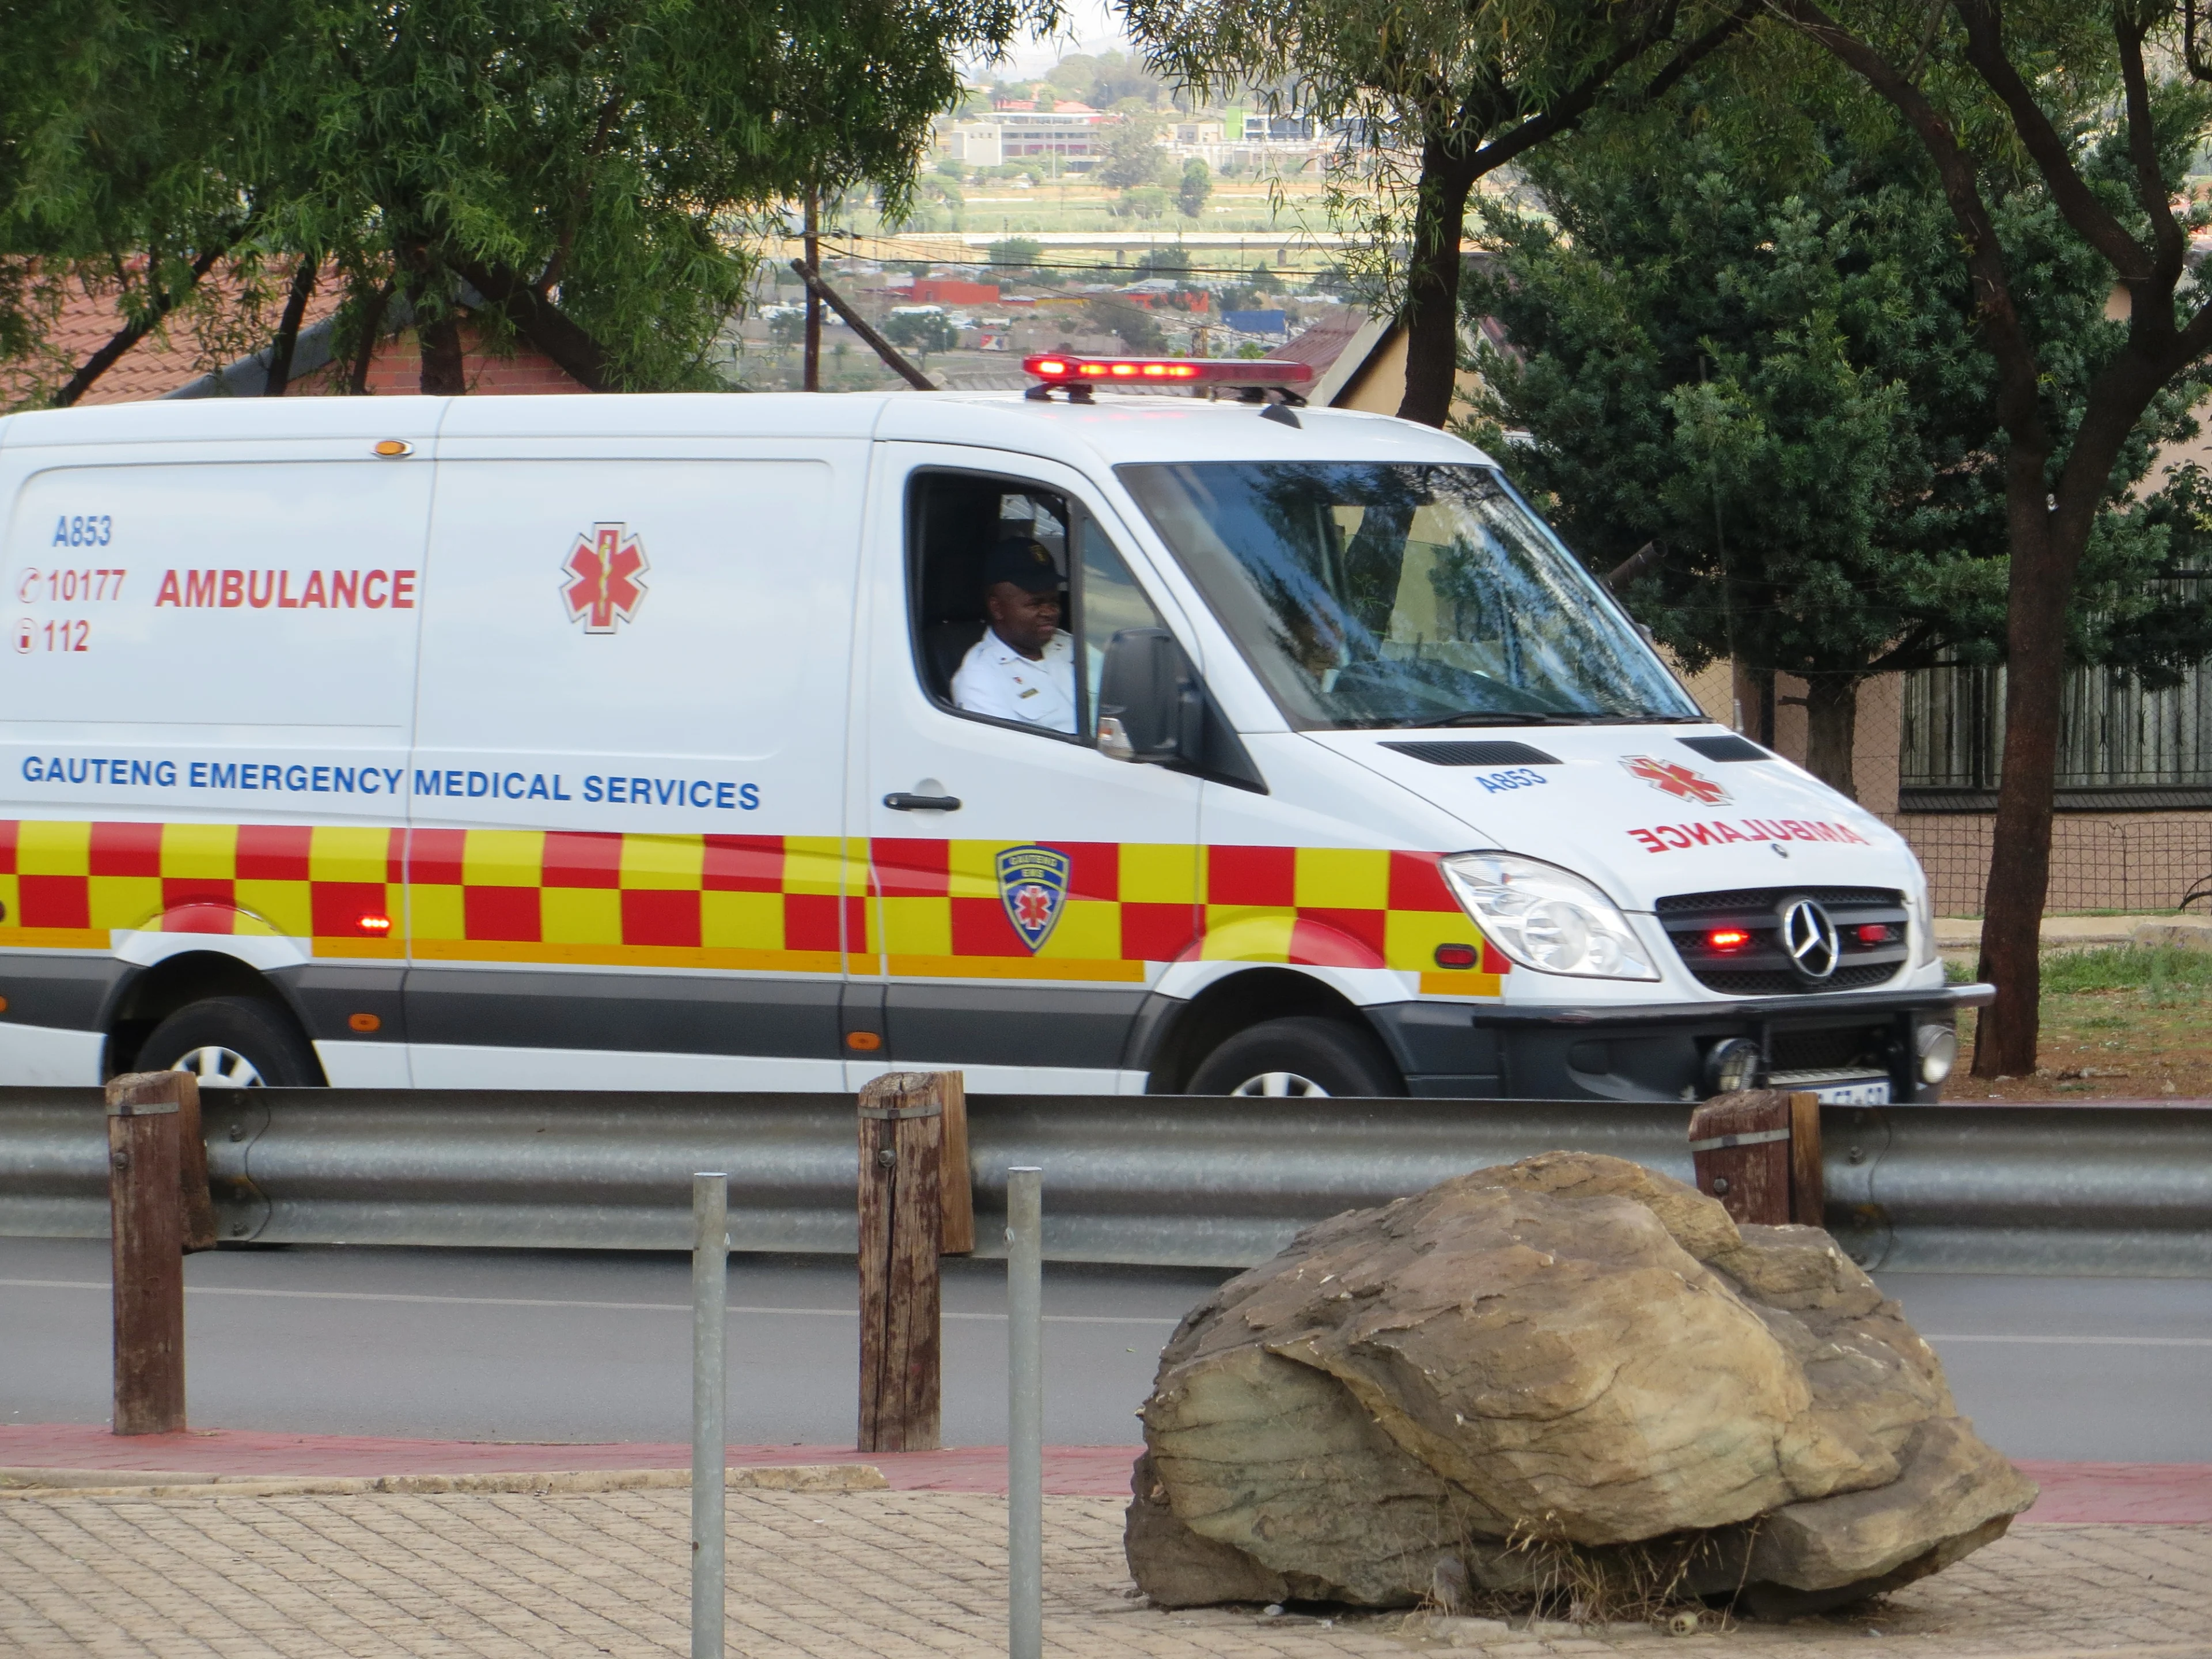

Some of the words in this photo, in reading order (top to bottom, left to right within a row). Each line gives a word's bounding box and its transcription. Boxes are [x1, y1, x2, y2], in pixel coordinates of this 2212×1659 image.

[51, 514, 112, 547] A853
[47, 570, 127, 601] 10177
[154, 569, 418, 609] AMBULANCE
[44, 620, 91, 652] 112
[20, 755, 176, 787] GAUTENG
[187, 761, 404, 794] EMERGENCY
[413, 768, 573, 801] MEDICAL
[581, 775, 761, 811] SERVICES
[1474, 767, 1548, 794] A853
